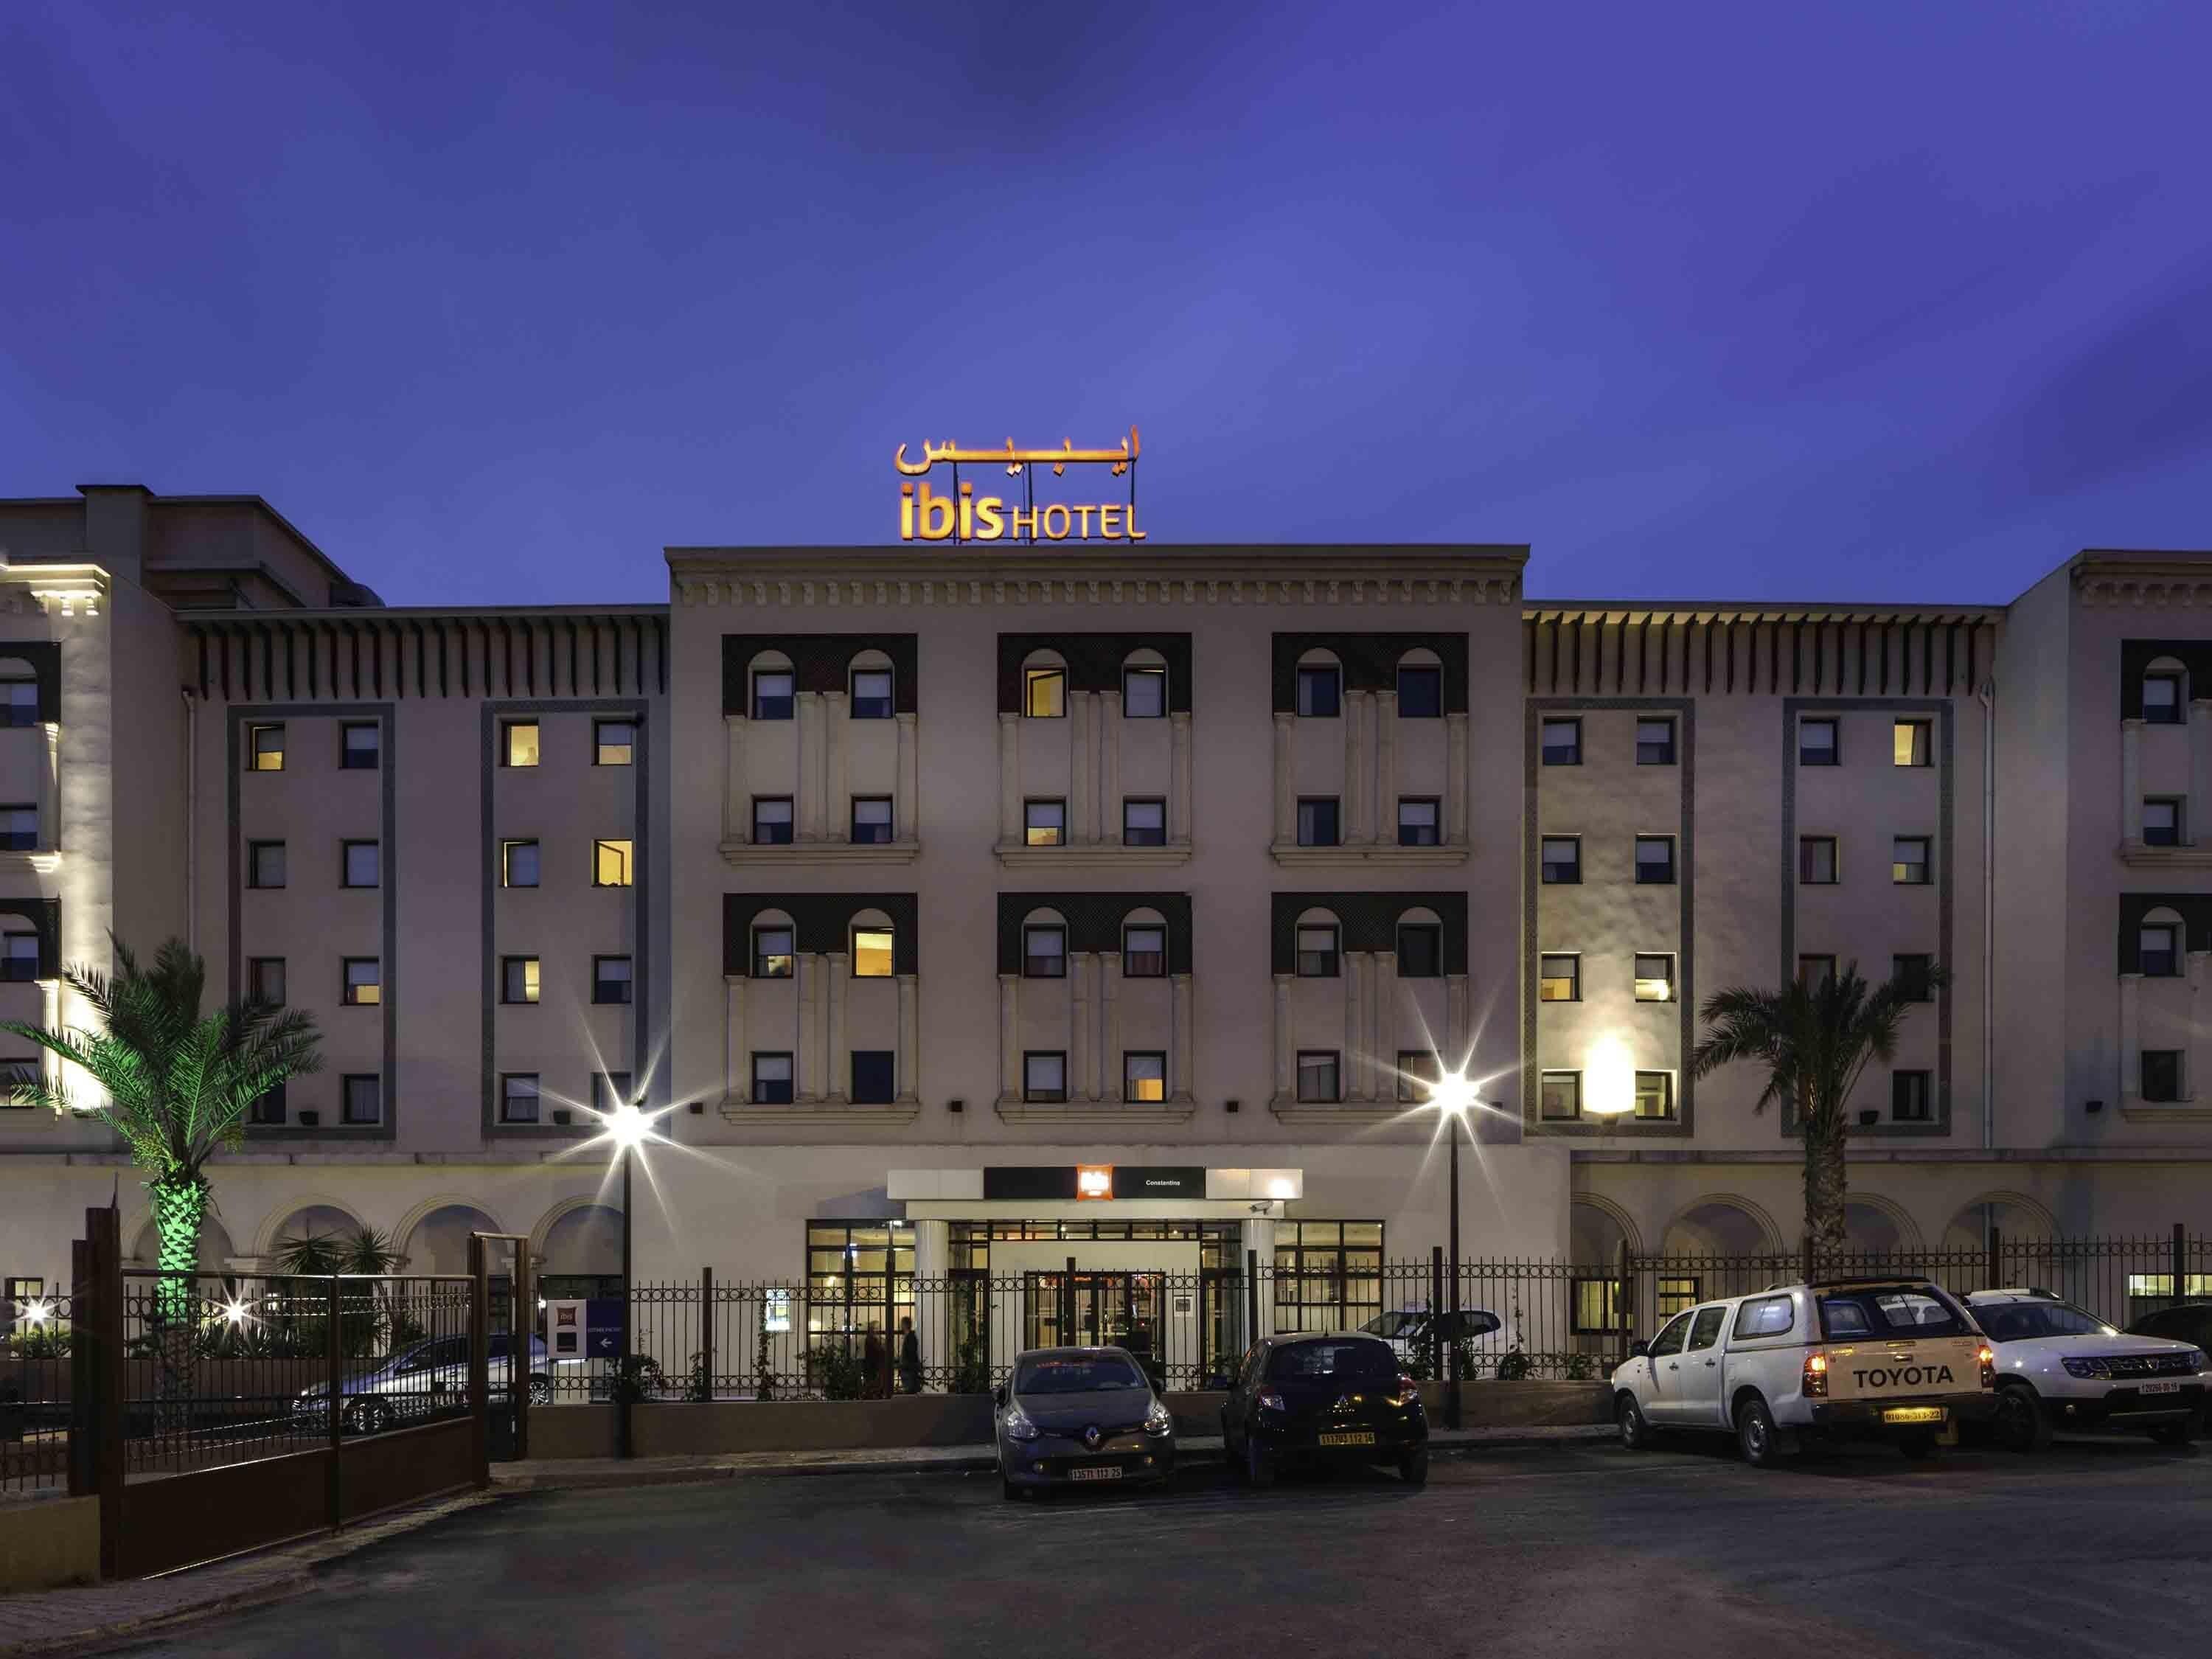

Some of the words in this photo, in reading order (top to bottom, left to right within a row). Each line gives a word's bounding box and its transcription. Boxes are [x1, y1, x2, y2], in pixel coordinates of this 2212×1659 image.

[900, 482, 1004, 540] ibis
[1012, 504, 1147, 540] HOTEL
[1852, 1365, 1954, 1388] TOYOTA
